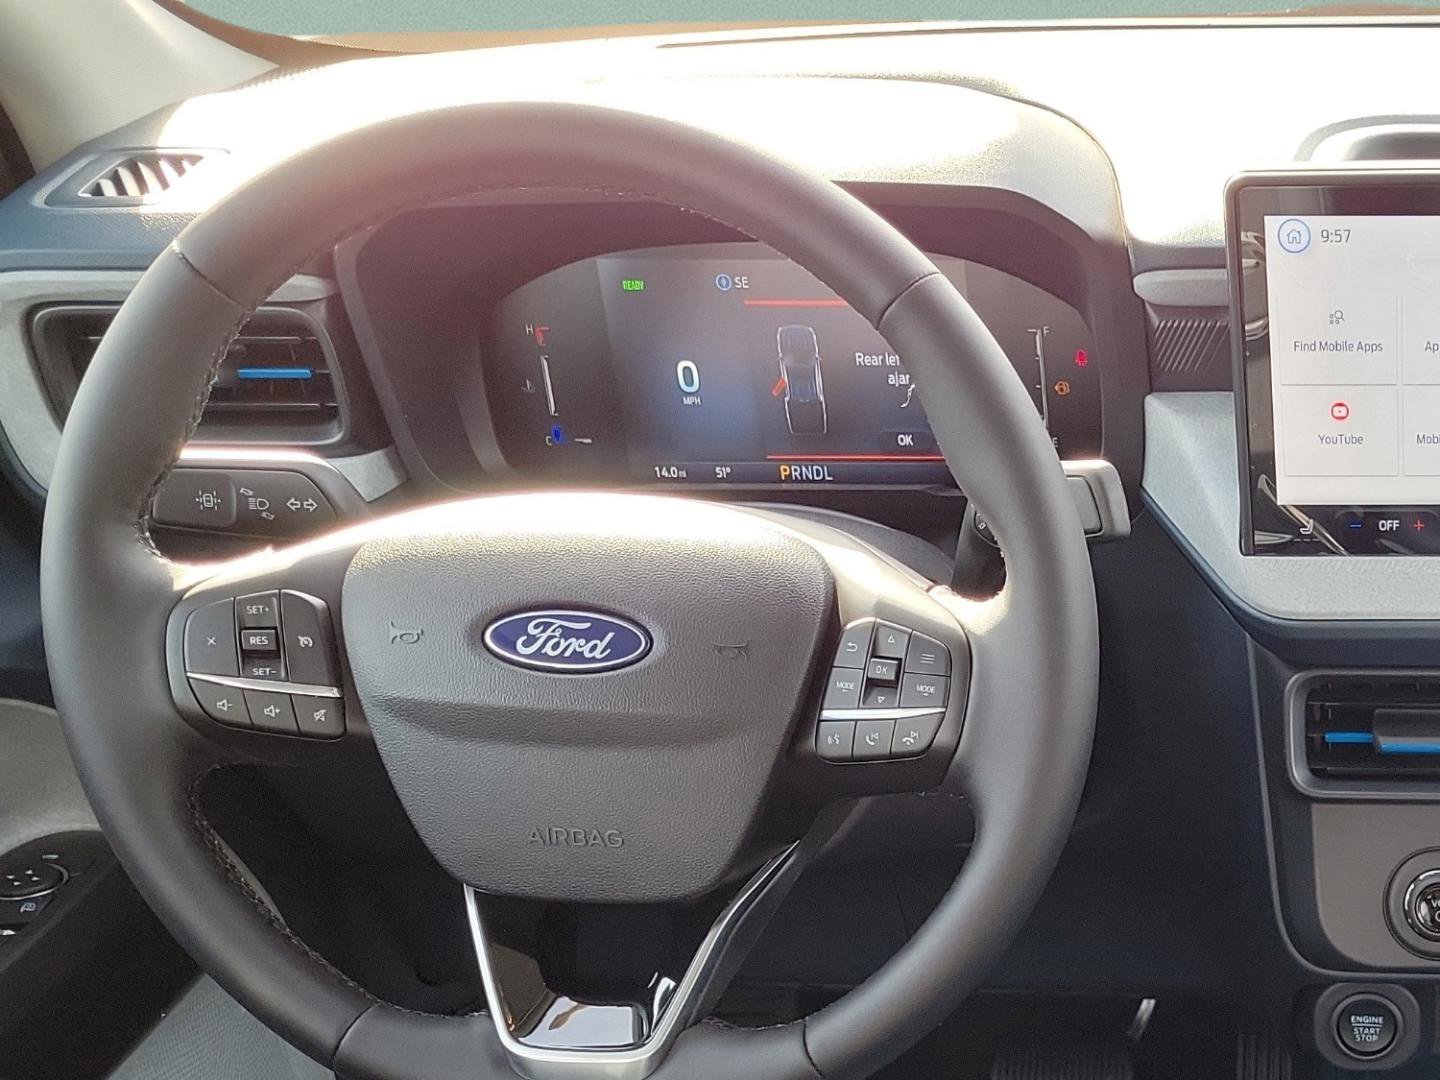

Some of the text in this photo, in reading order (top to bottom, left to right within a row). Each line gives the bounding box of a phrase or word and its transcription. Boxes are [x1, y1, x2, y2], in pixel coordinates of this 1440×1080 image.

[1320, 228, 1352, 244] 9:57
[734, 276, 750, 289] SE
[1292, 340, 1383, 354] Find Mobile Apps
[855, 352, 883, 367] Rear
[676, 360, 701, 393] 0
[888, 371, 910, 387] ajar
[682, 396, 702, 406] MPH
[897, 434, 914, 446] OK
[1317, 433, 1364, 446] YouTube
[654, 466, 678, 478] 14.0
[715, 466, 732, 479] 51°
[779, 464, 834, 481] PRNDL
[1378, 519, 1400, 532] OFF
[249, 636, 269, 645] RES
[515, 617, 616, 659] Ford
[875, 665, 888, 675] OK
[836, 681, 854, 690] MODE
[916, 685, 936, 694] MODE
[529, 826, 625, 849] AIRBAG
[1350, 1015, 1384, 1024] ENGINE
[1353, 1026, 1381, 1035] START
[1354, 1034, 1379, 1042] STOP
